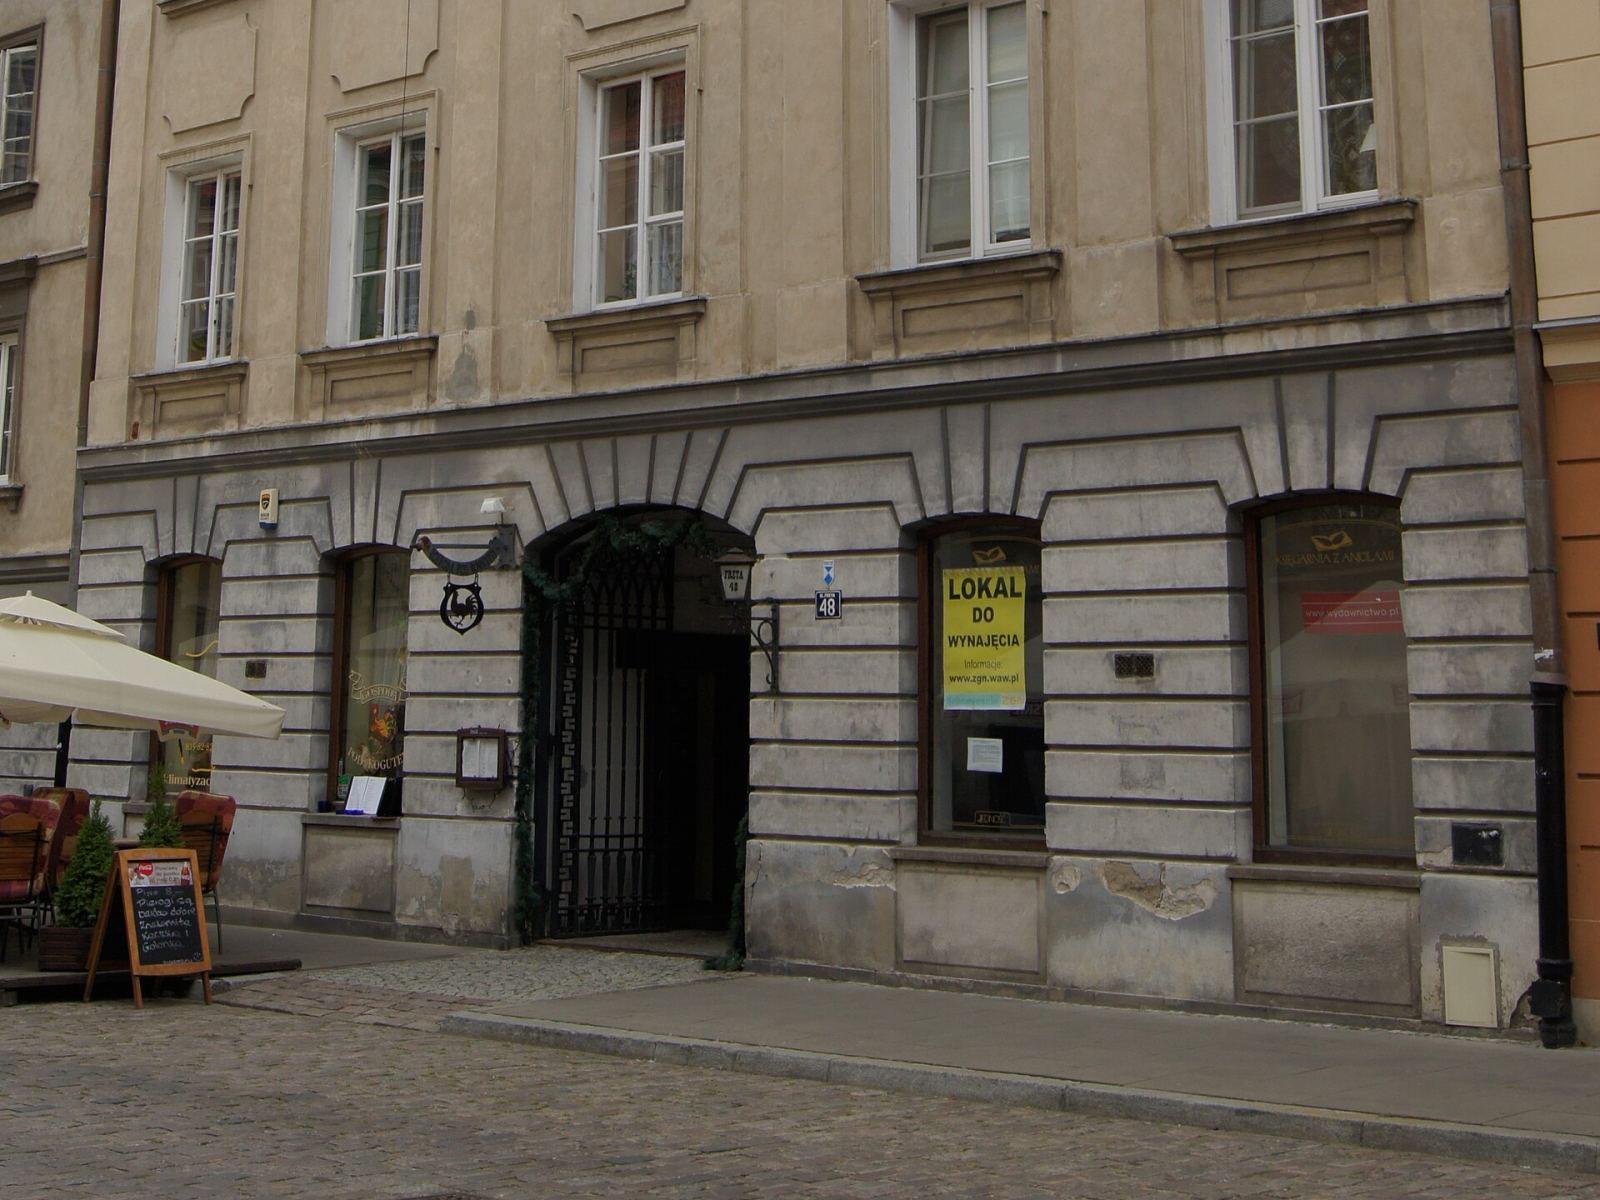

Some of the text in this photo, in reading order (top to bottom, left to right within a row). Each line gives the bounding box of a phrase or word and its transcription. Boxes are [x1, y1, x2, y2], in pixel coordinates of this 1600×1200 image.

[724, 569, 744, 580] FRETA
[729, 582, 738, 592] 48
[949, 576, 1023, 600] LOKAL
[819, 598, 836, 616] 48
[972, 607, 995, 624] DO
[948, 634, 1020, 650] WYNAJĘCIA
[949, 672, 1020, 684] www.zgn.waw.pl
